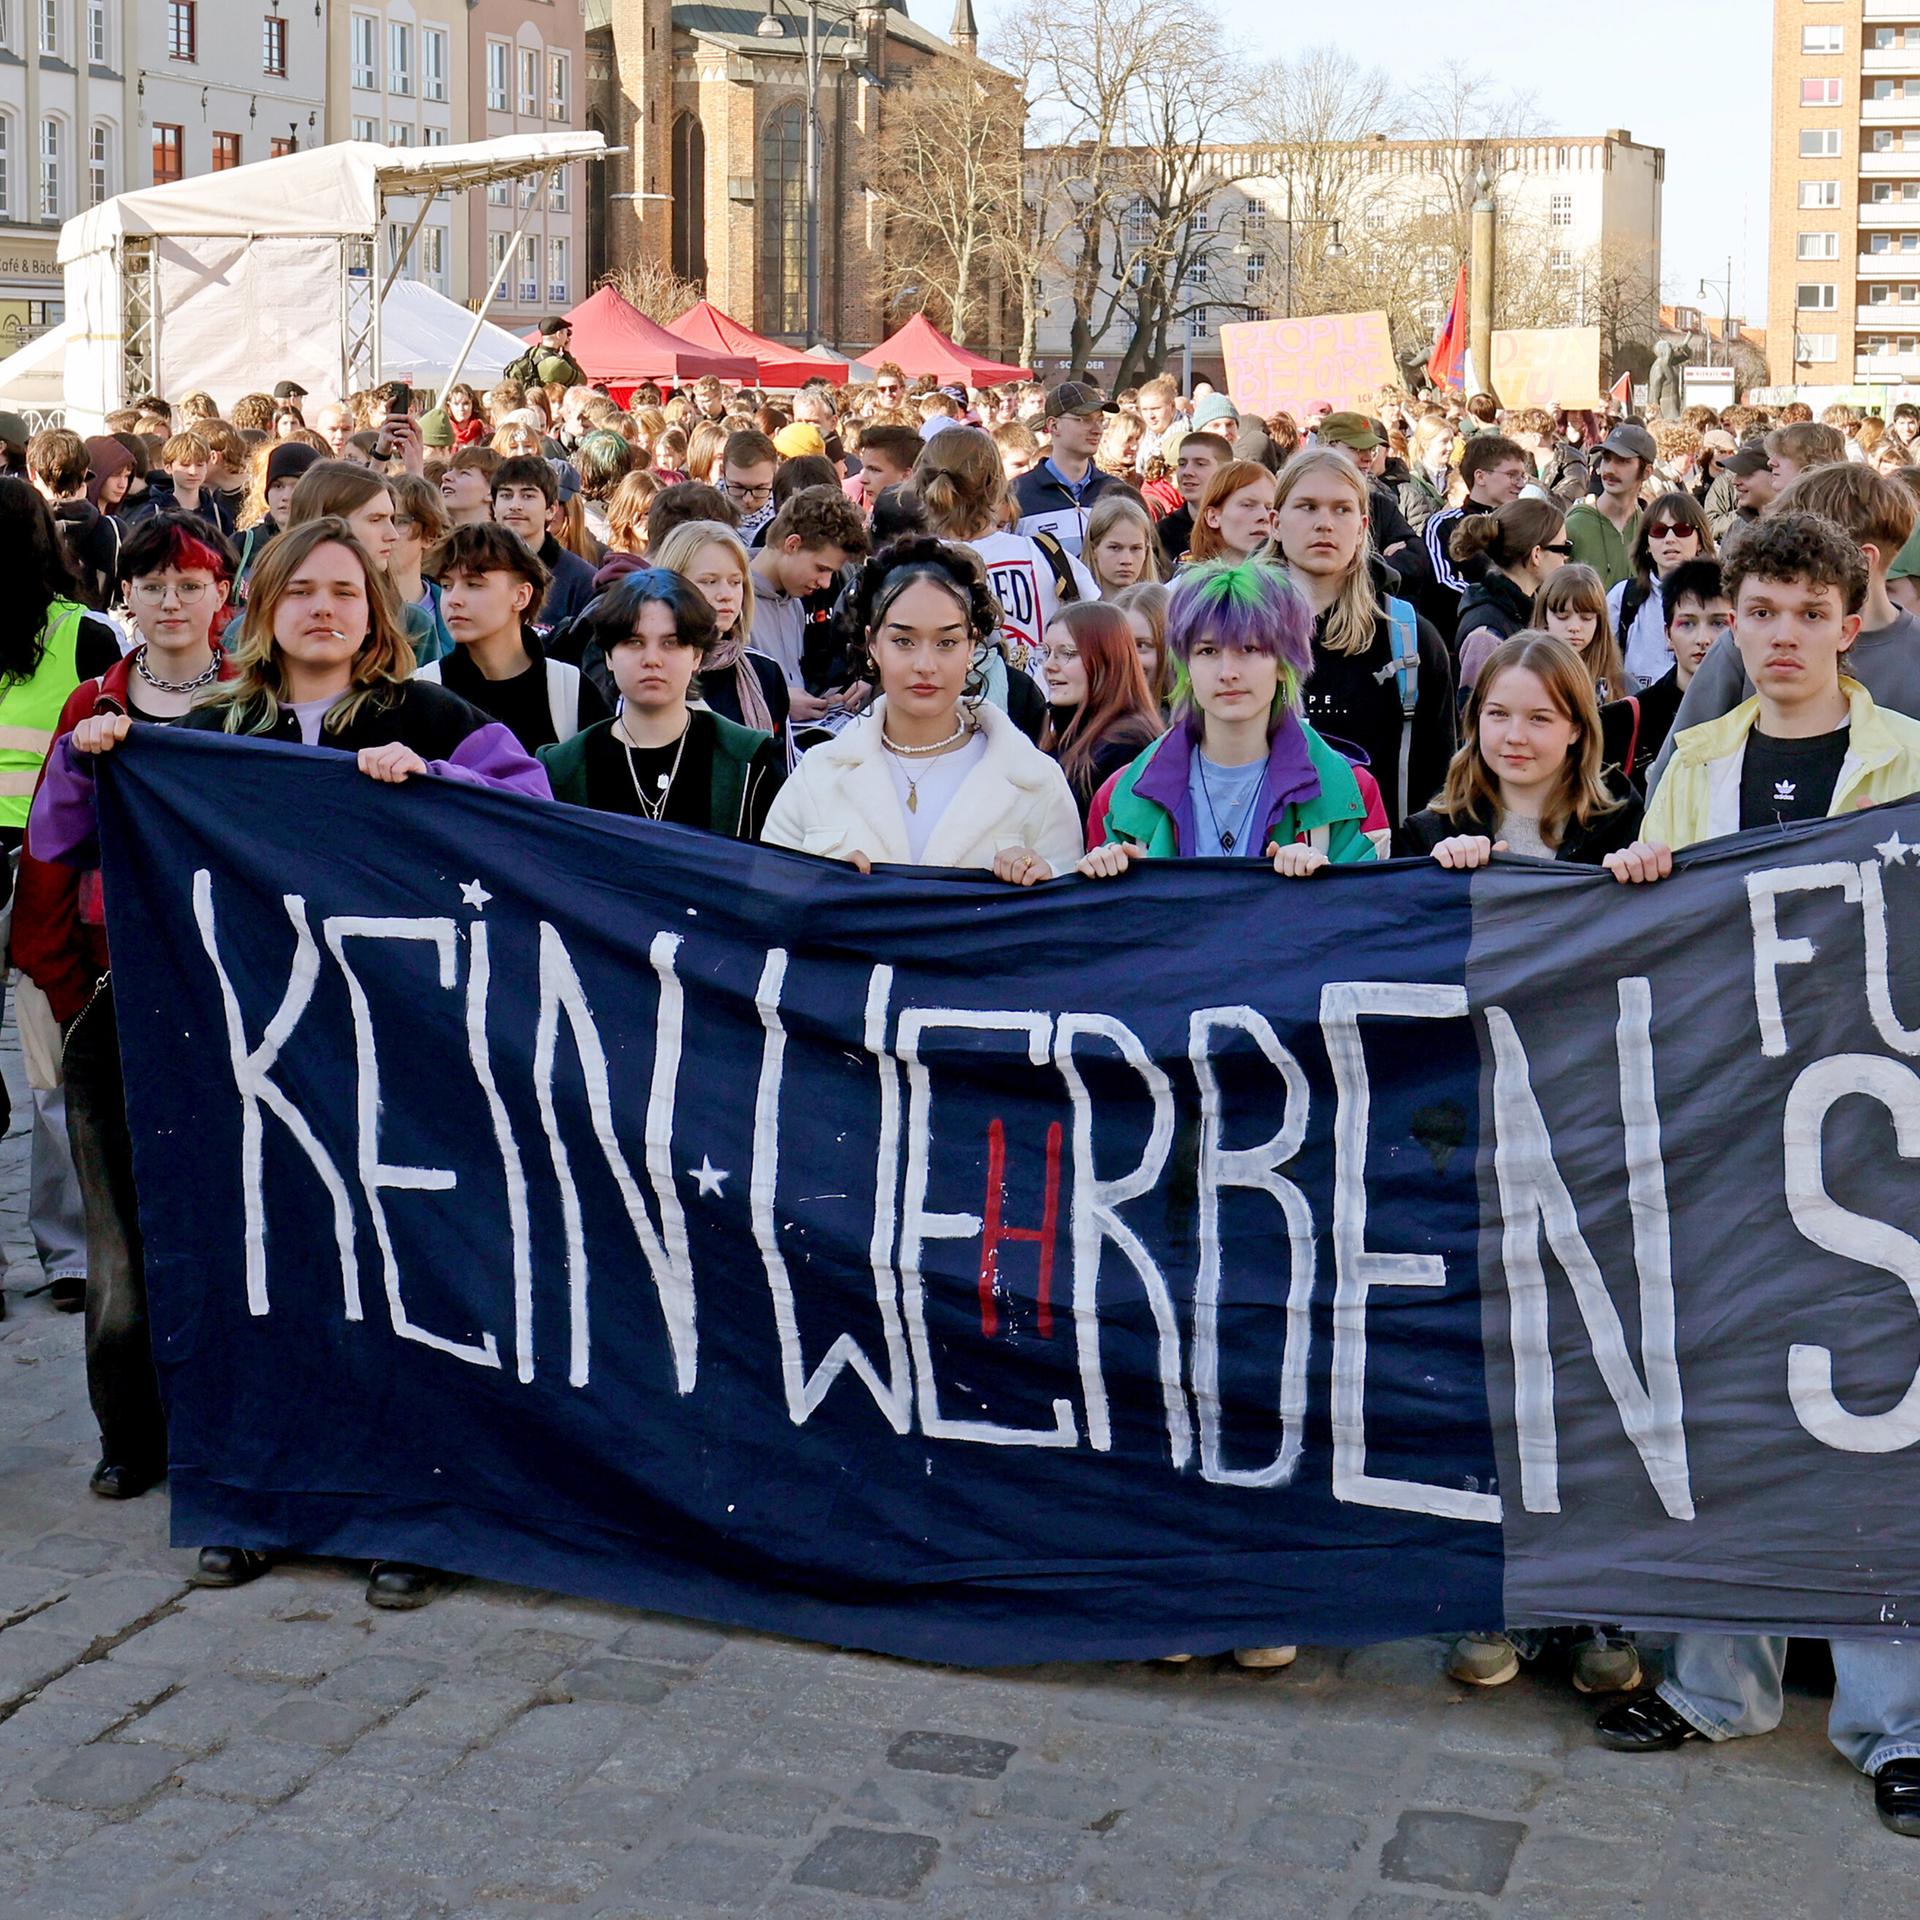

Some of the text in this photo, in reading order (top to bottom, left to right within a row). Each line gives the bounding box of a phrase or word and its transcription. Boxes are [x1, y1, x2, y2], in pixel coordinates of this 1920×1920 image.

[0, 258, 19, 272] afé
[22, 259, 29, 273] &
[1231, 315, 1384, 358] PEOPLE
[1230, 351, 1389, 402] BEFORE
[988, 569, 1032, 625] ED
[192, 868, 698, 1395] KEIN
